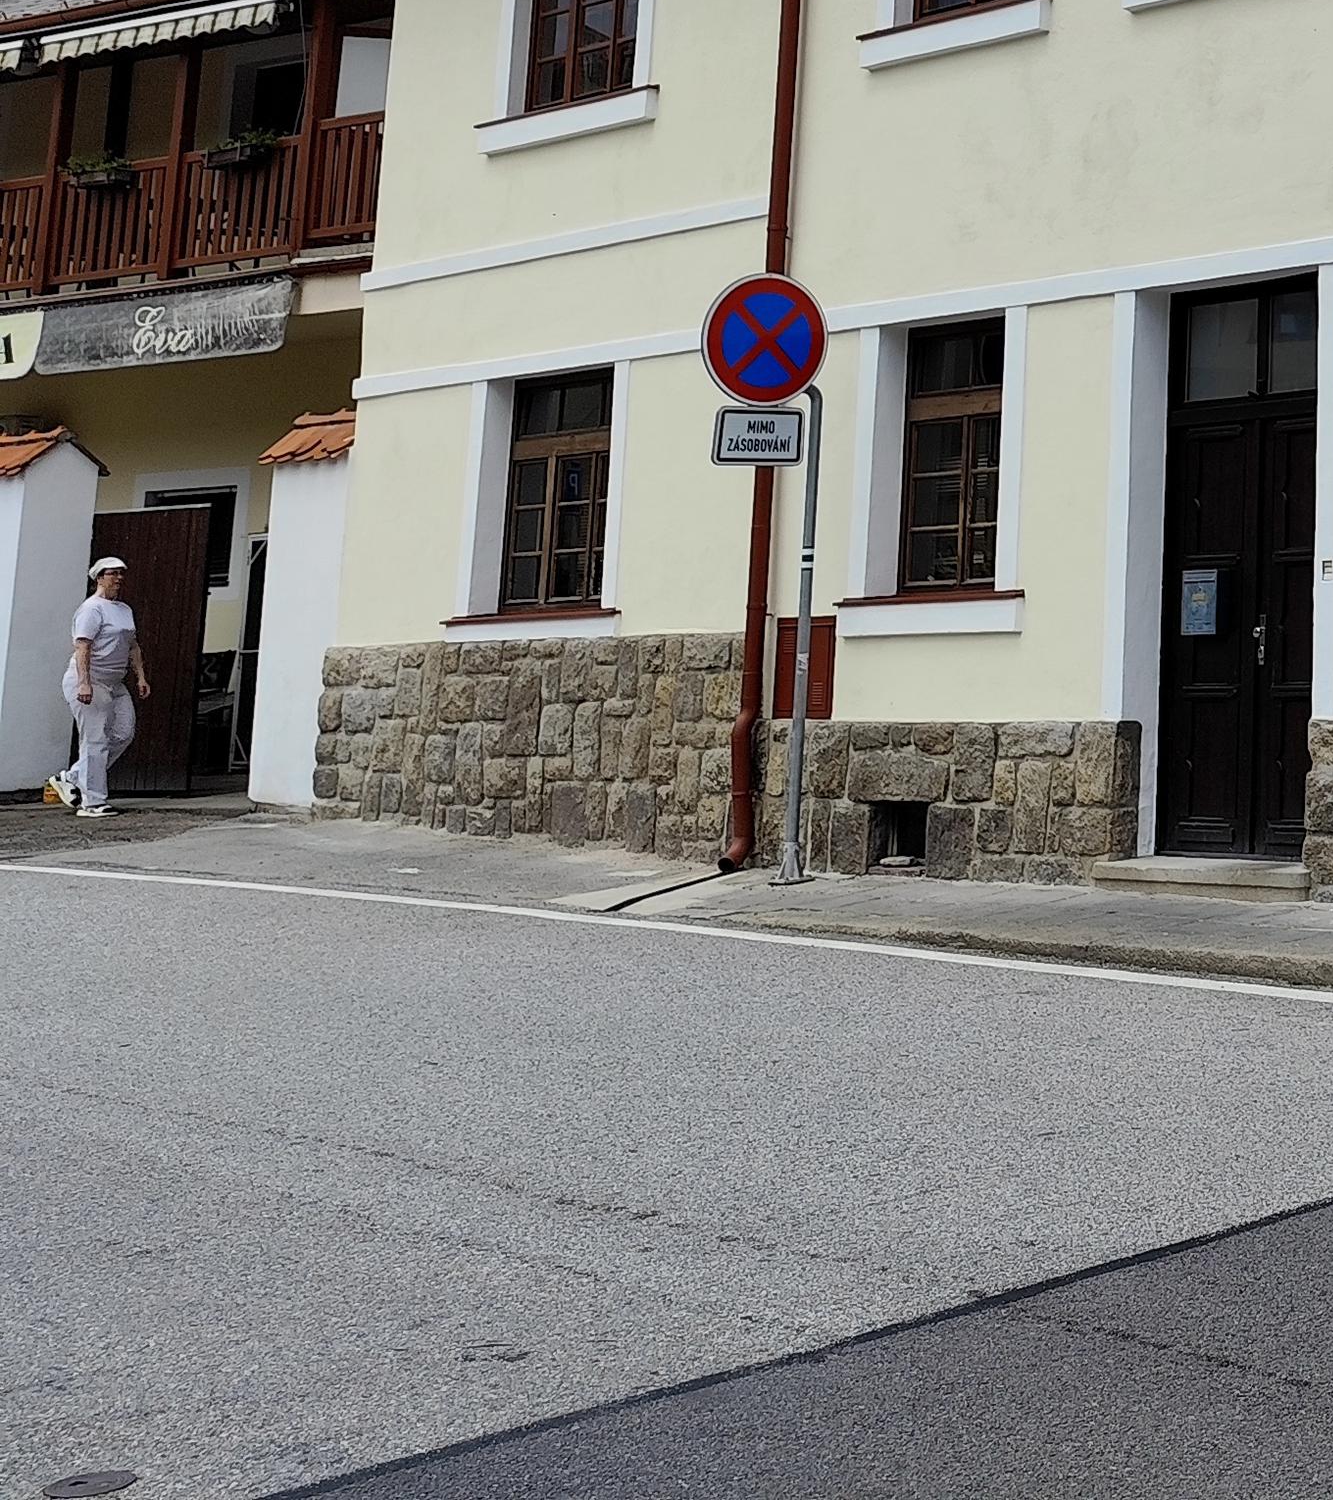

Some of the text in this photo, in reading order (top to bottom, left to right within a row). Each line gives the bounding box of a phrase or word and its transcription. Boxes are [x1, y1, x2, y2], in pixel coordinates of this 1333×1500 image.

[132, 306, 195, 357] Eva
[747, 420, 775, 434] MIMO
[727, 435, 791, 452] ZÁSOBOVÁNÍ
